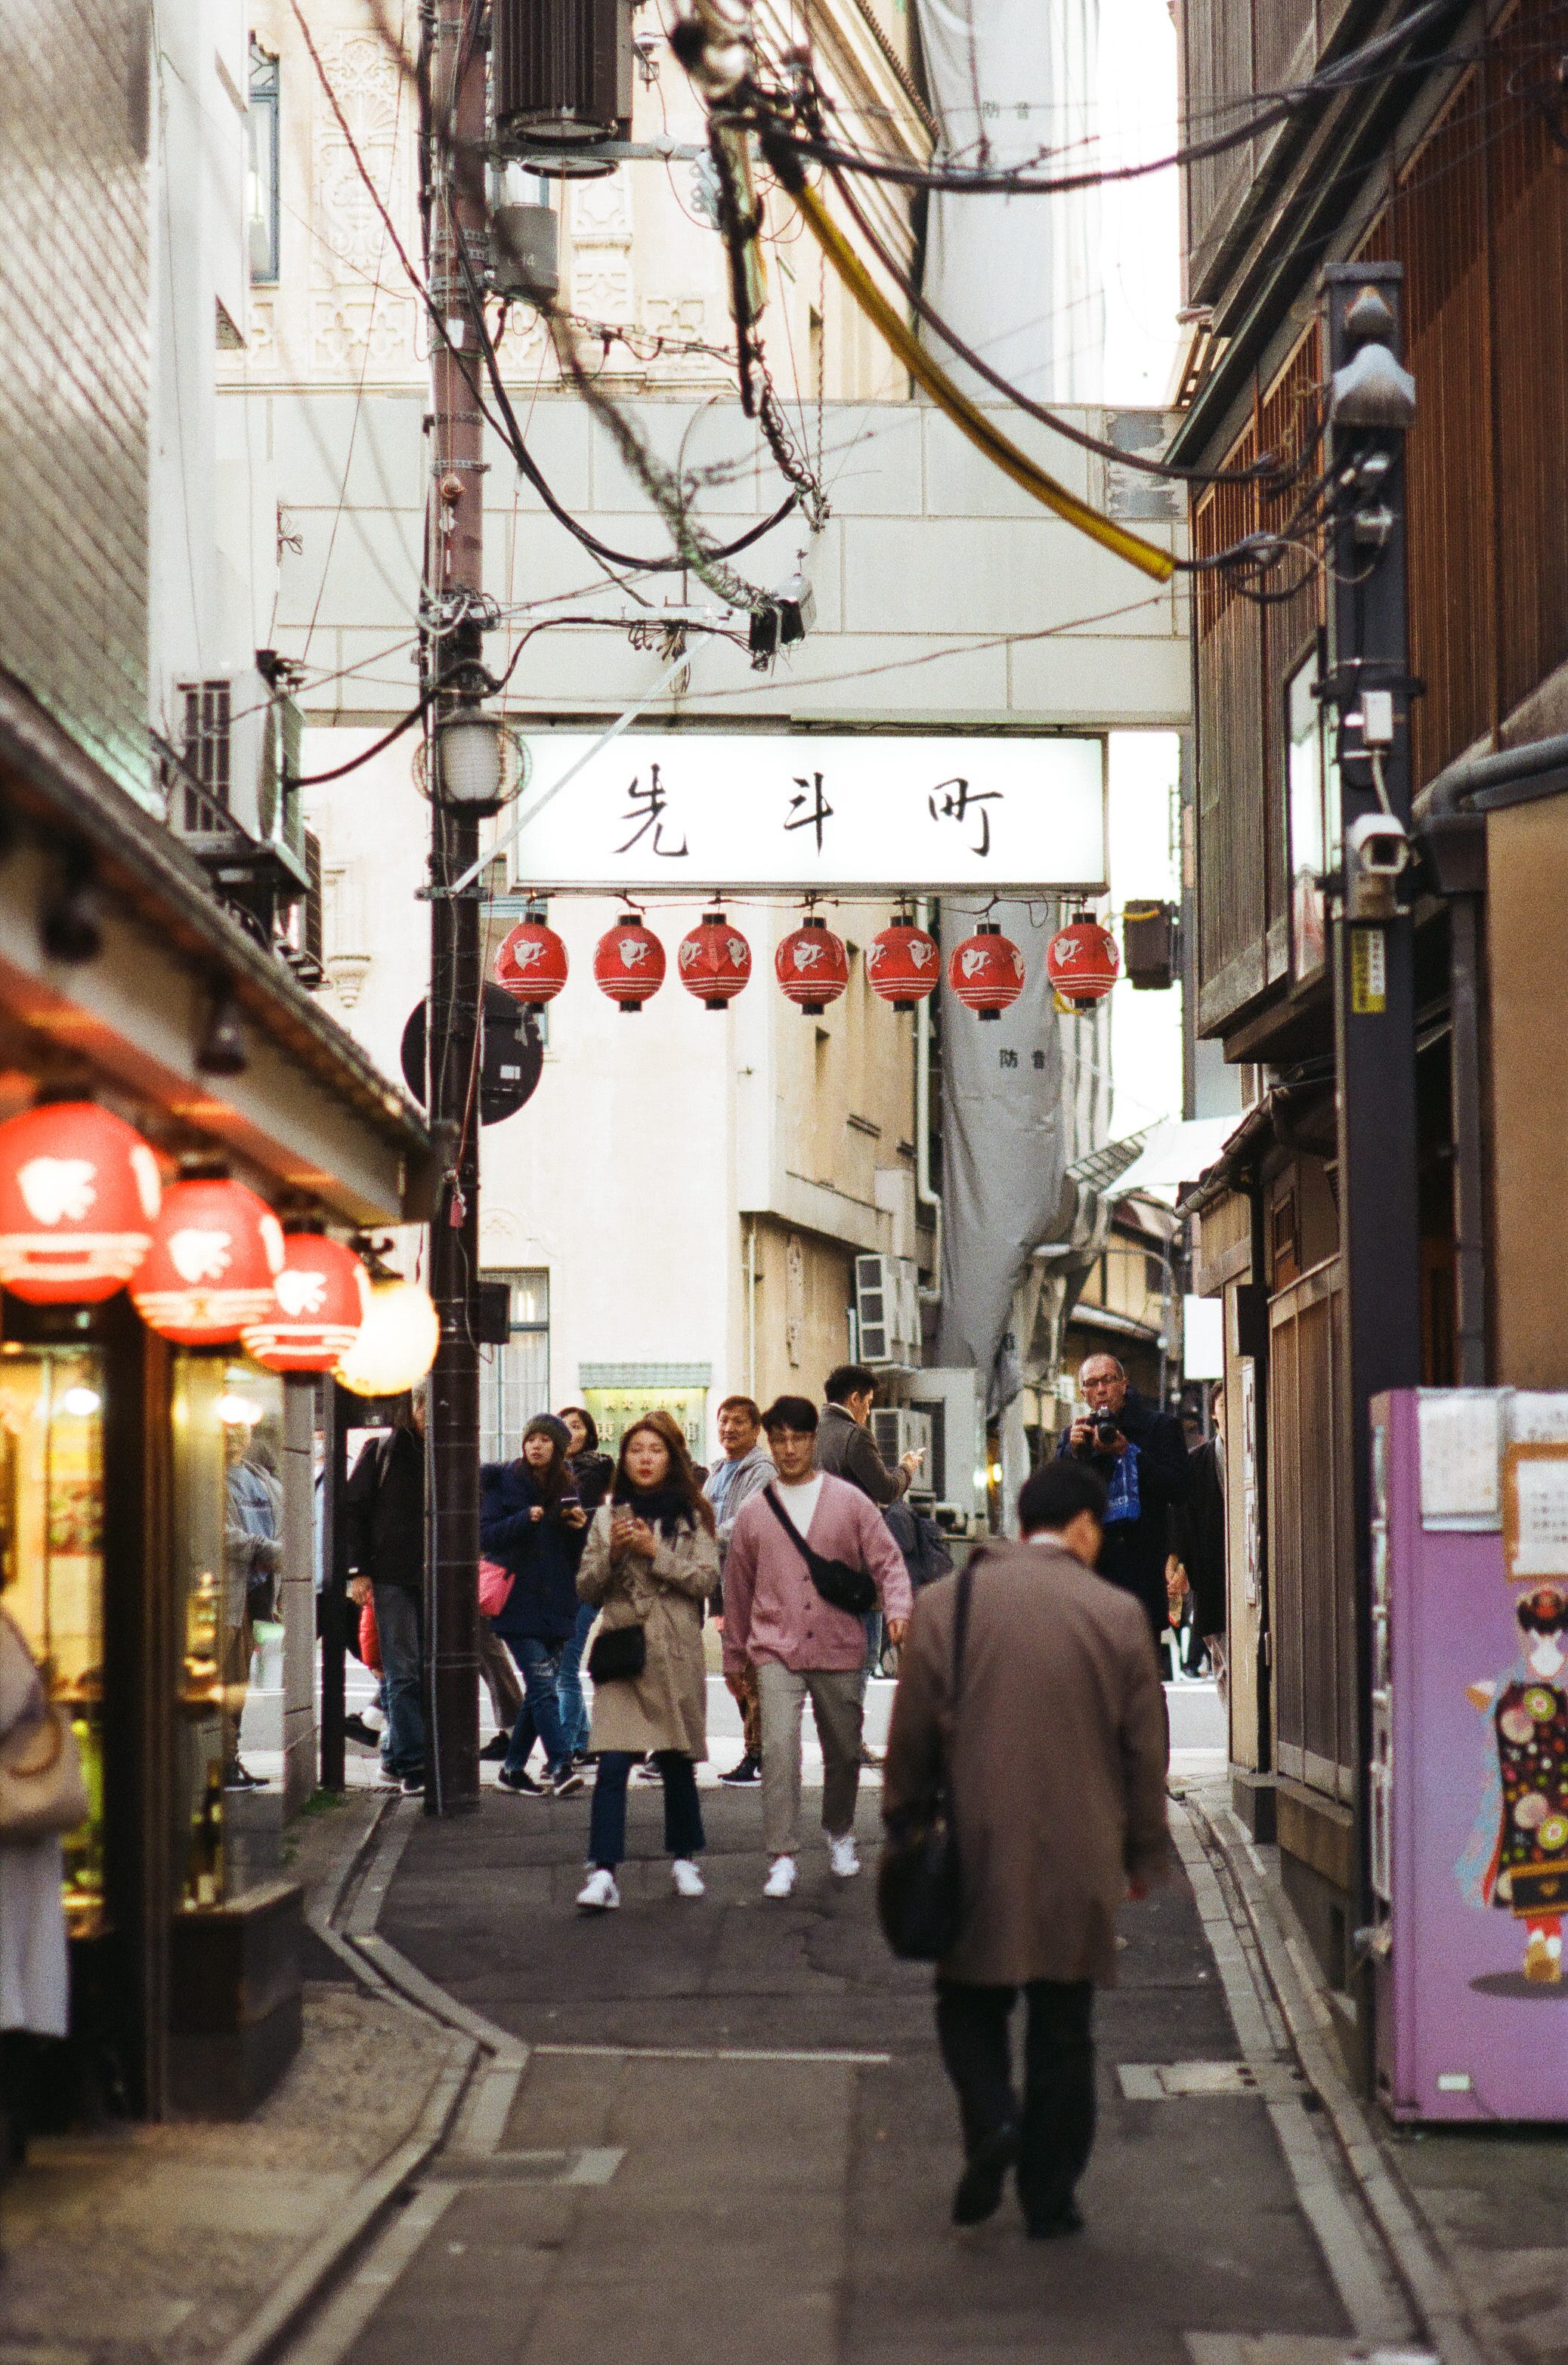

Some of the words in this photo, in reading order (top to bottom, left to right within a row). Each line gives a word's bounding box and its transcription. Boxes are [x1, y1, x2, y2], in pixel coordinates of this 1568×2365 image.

[614, 762, 1004, 858] 先斗町
[1000, 1050, 1046, 1069] 防音
